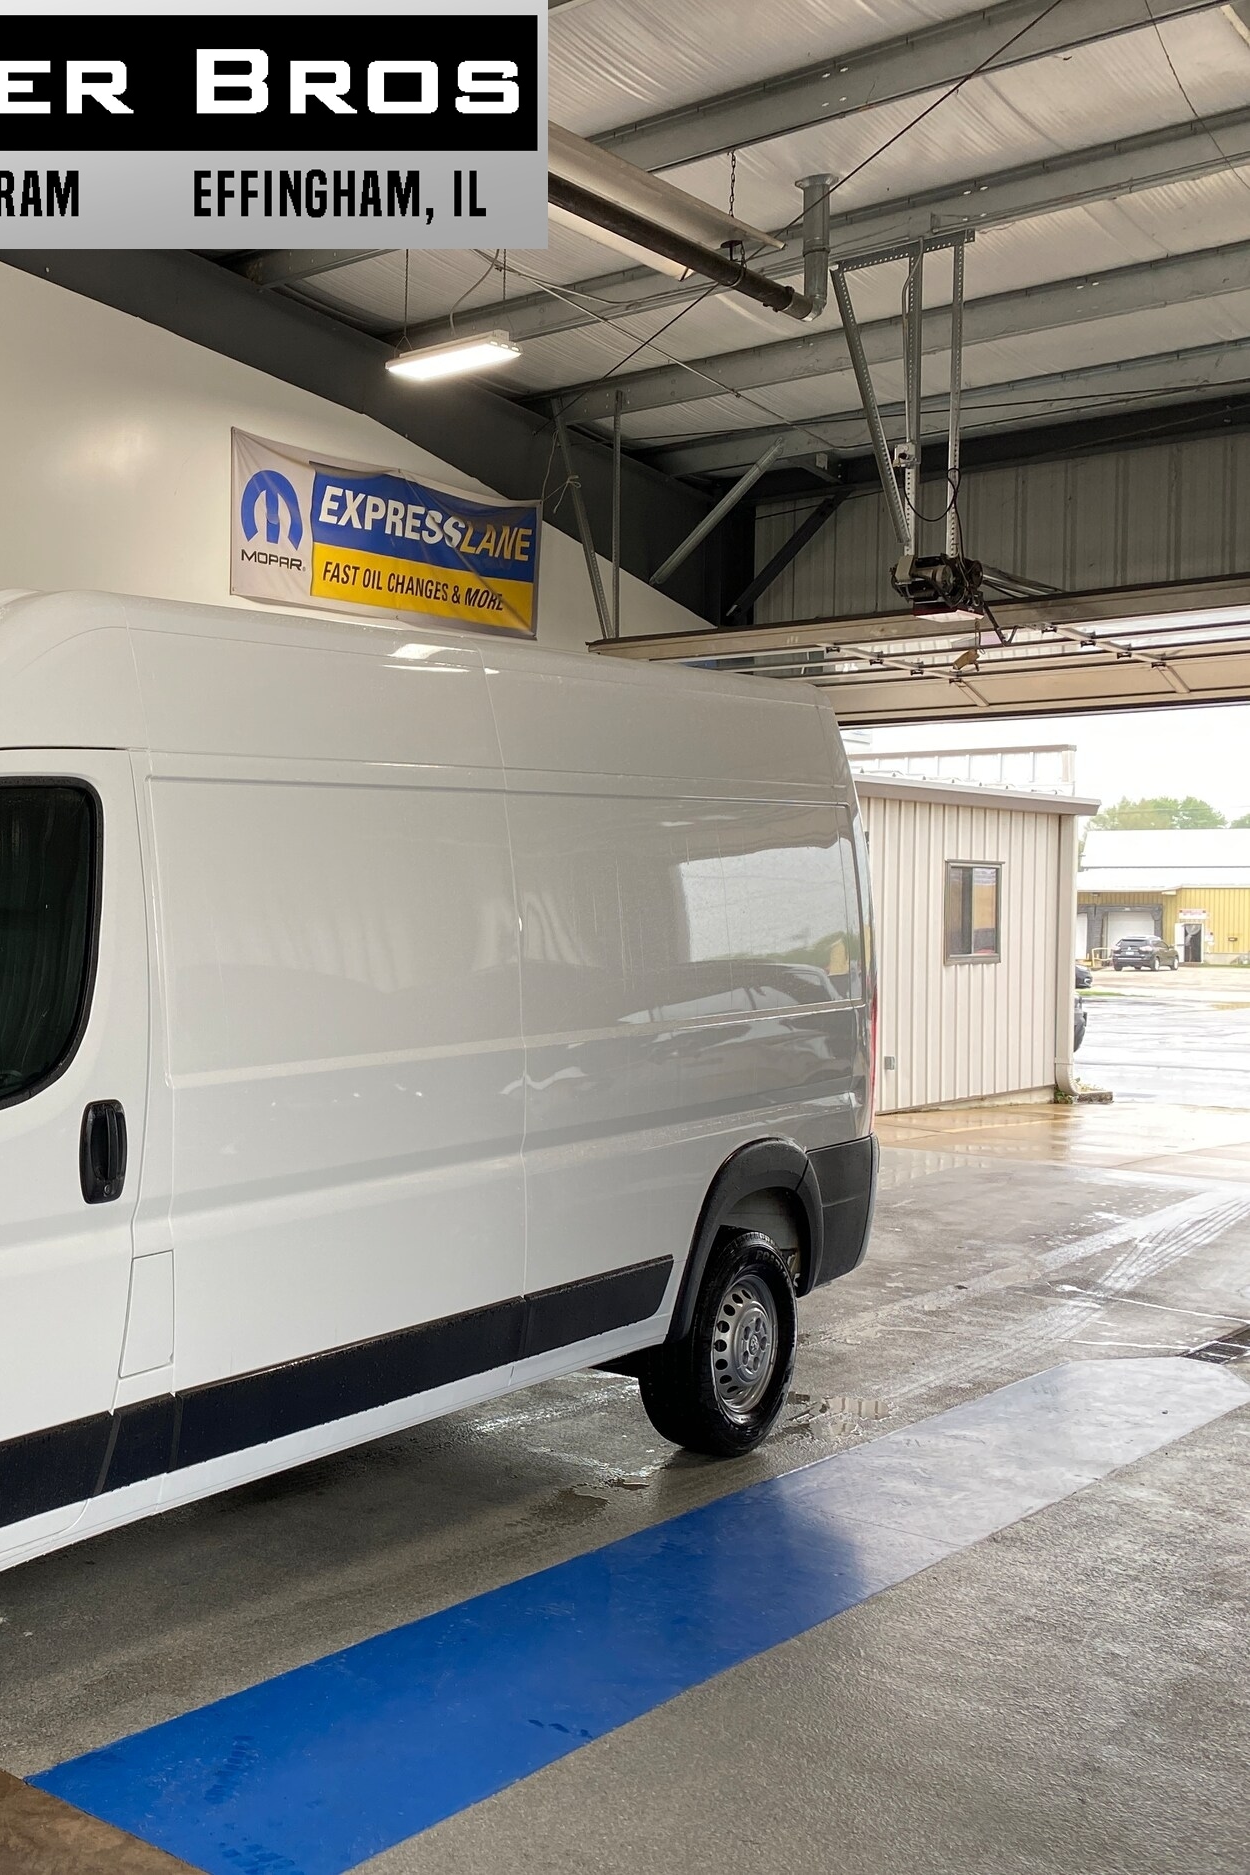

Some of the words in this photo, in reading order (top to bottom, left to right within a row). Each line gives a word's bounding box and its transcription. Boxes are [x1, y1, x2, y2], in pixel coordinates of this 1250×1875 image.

[241, 549, 302, 571] MOPAR
[323, 561, 360, 586] FAST
[363, 568, 383, 591] OIL
[388, 573, 449, 602] CHANGES
[452, 586, 461, 604] &
[465, 588, 503, 611] MORE
